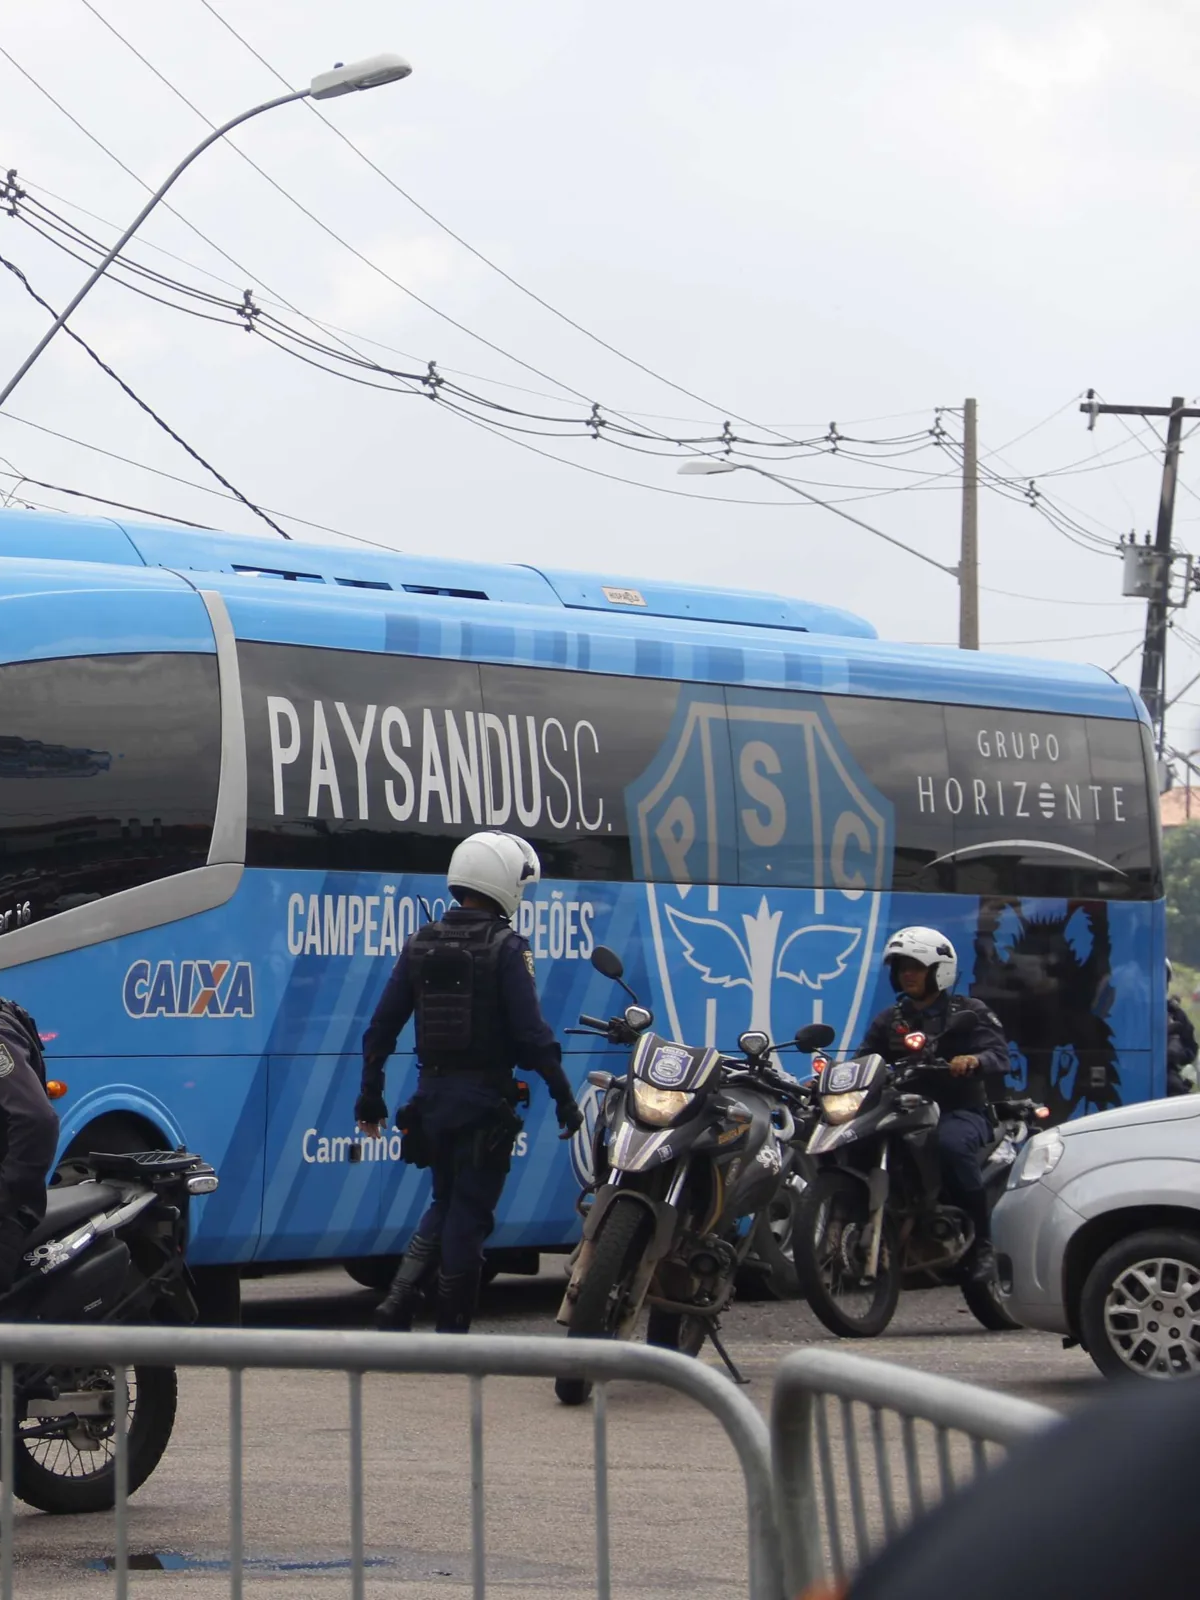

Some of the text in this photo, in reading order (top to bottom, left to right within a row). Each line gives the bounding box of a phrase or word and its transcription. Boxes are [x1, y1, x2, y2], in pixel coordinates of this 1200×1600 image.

[266, 695, 542, 828] PAYSANDU
[977, 730, 1060, 761] GRUPO
[917, 775, 1126, 822] HORIZONTE
[16, 901, 31, 926] i6
[287, 884, 414, 957] CAMPEÃO
[122, 959, 255, 1019] CAIXA
